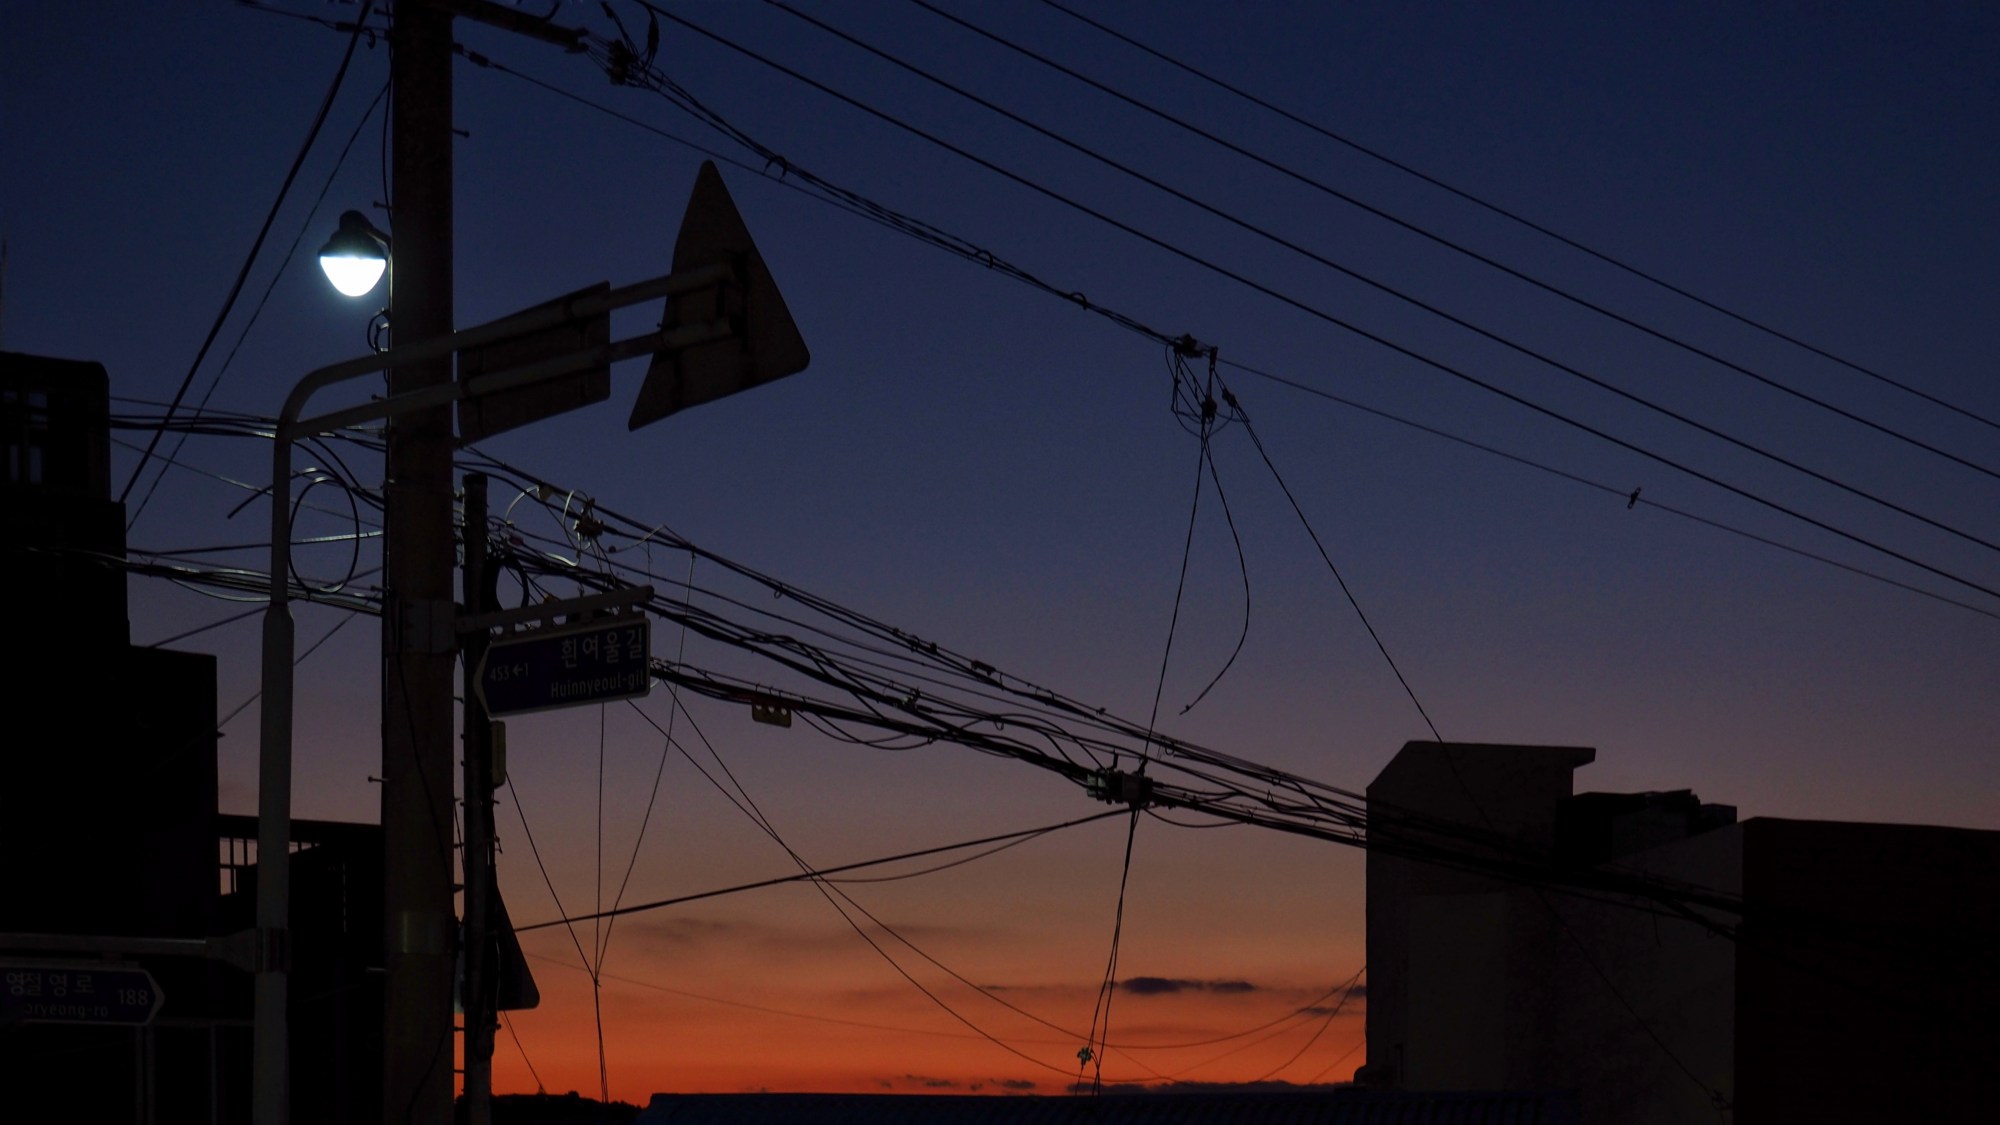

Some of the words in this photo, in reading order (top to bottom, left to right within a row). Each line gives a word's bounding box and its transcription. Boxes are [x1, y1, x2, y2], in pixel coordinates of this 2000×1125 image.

[560, 627, 644, 669] 흰여울길
[488, 664, 511, 682] 453
[550, 668, 645, 699] Huinnyeoul-gil
[118, 988, 149, 1006] 188
